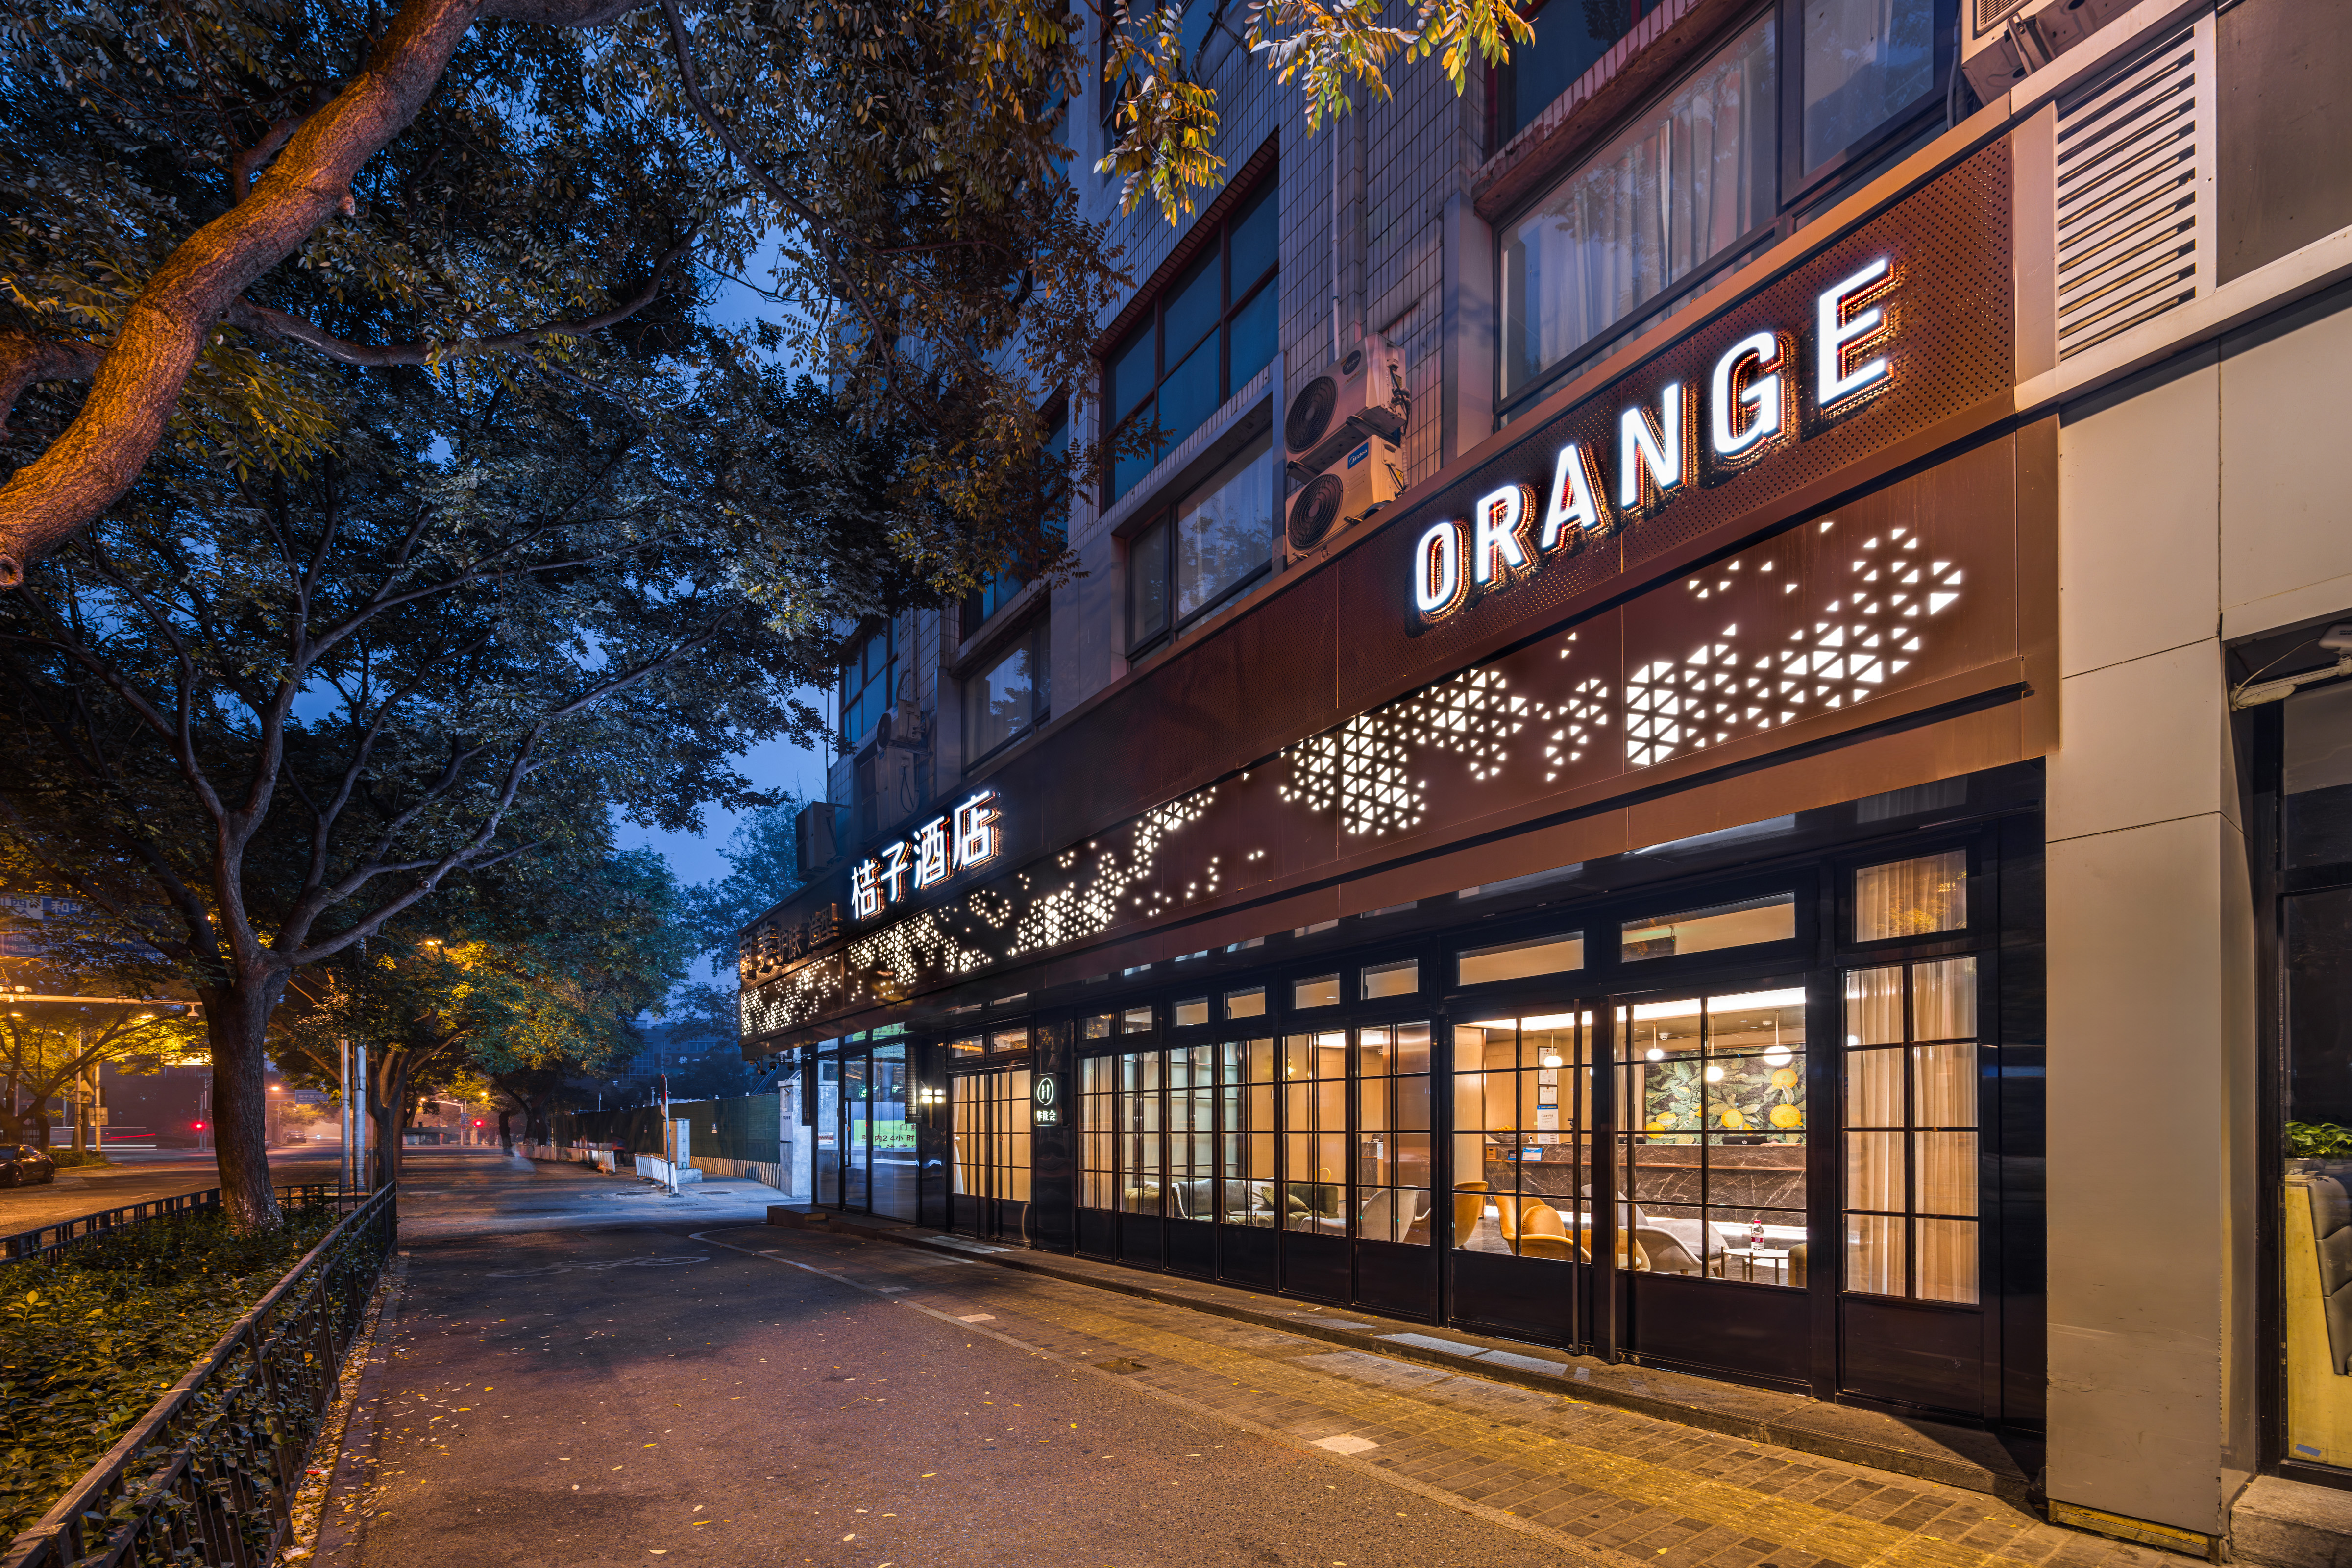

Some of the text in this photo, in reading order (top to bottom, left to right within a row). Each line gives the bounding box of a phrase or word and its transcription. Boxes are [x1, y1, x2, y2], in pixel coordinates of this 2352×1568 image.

[1349, 449, 1367, 465] Midea
[1415, 257, 1892, 613] ORANGE
[851, 790, 998, 920] 桔子酒店
